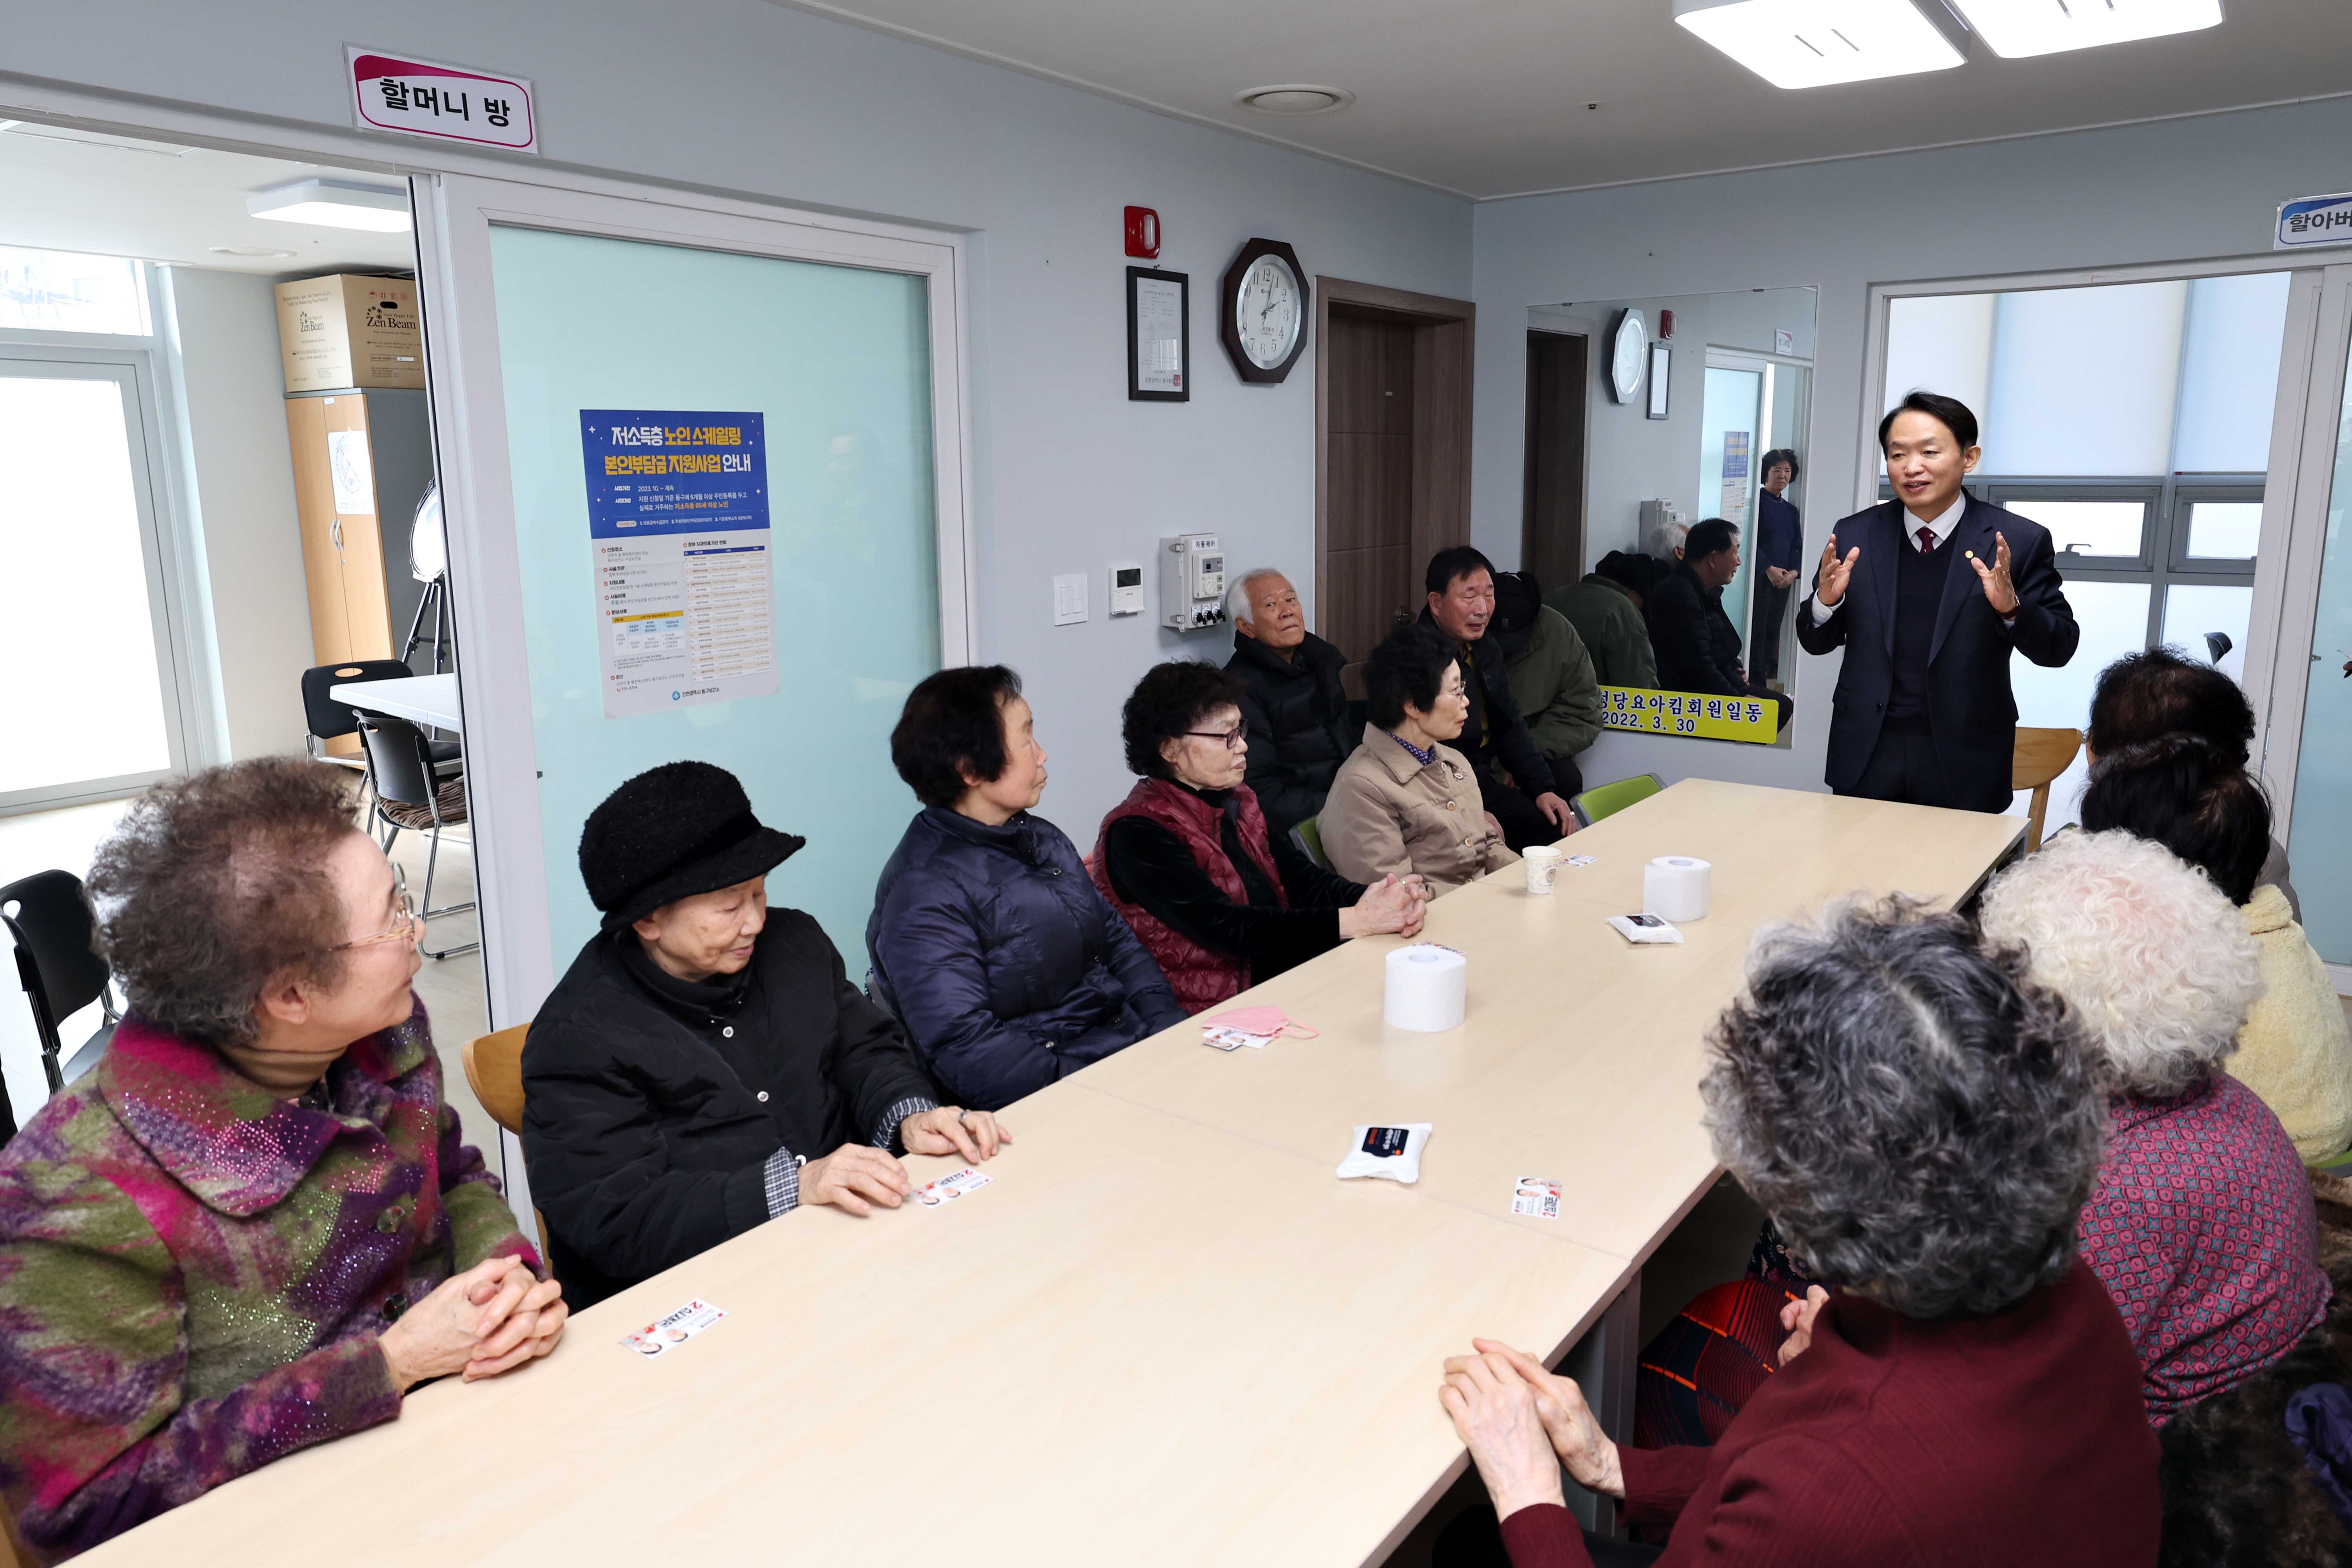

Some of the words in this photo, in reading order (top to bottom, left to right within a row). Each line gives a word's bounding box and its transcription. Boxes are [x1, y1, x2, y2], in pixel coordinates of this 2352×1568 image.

[380, 78, 469, 121] 할머니
[484, 98, 510, 127] 방
[1253, 271, 1259, 285] 11
[1262, 268, 1270, 281] 12
[1275, 276, 1279, 288] 1
[1281, 289, 1287, 301] 2
[1283, 308, 1289, 322] 3
[300, 322, 310, 332] Zen
[310, 321, 325, 331] Beam
[366, 316, 386, 327] Zen
[388, 318, 416, 329] Beam
[1279, 326, 1284, 339] 4
[1250, 338, 1255, 350] 7
[1260, 342, 1265, 356] 6
[1271, 339, 1276, 352] 5
[611, 426, 663, 446] 저소득층
[665, 427, 691, 445] 노인
[693, 427, 741, 445] 스케일링
[604, 456, 667, 475] 본인부담금
[668, 455, 721, 473] 지원사업
[722, 454, 751, 472] 안내
[682, 689, 701, 697] 인천광역시
[1602, 711, 1644, 728] 2022.
[1653, 716, 1667, 730] 3.
[1676, 718, 1695, 732] 30
